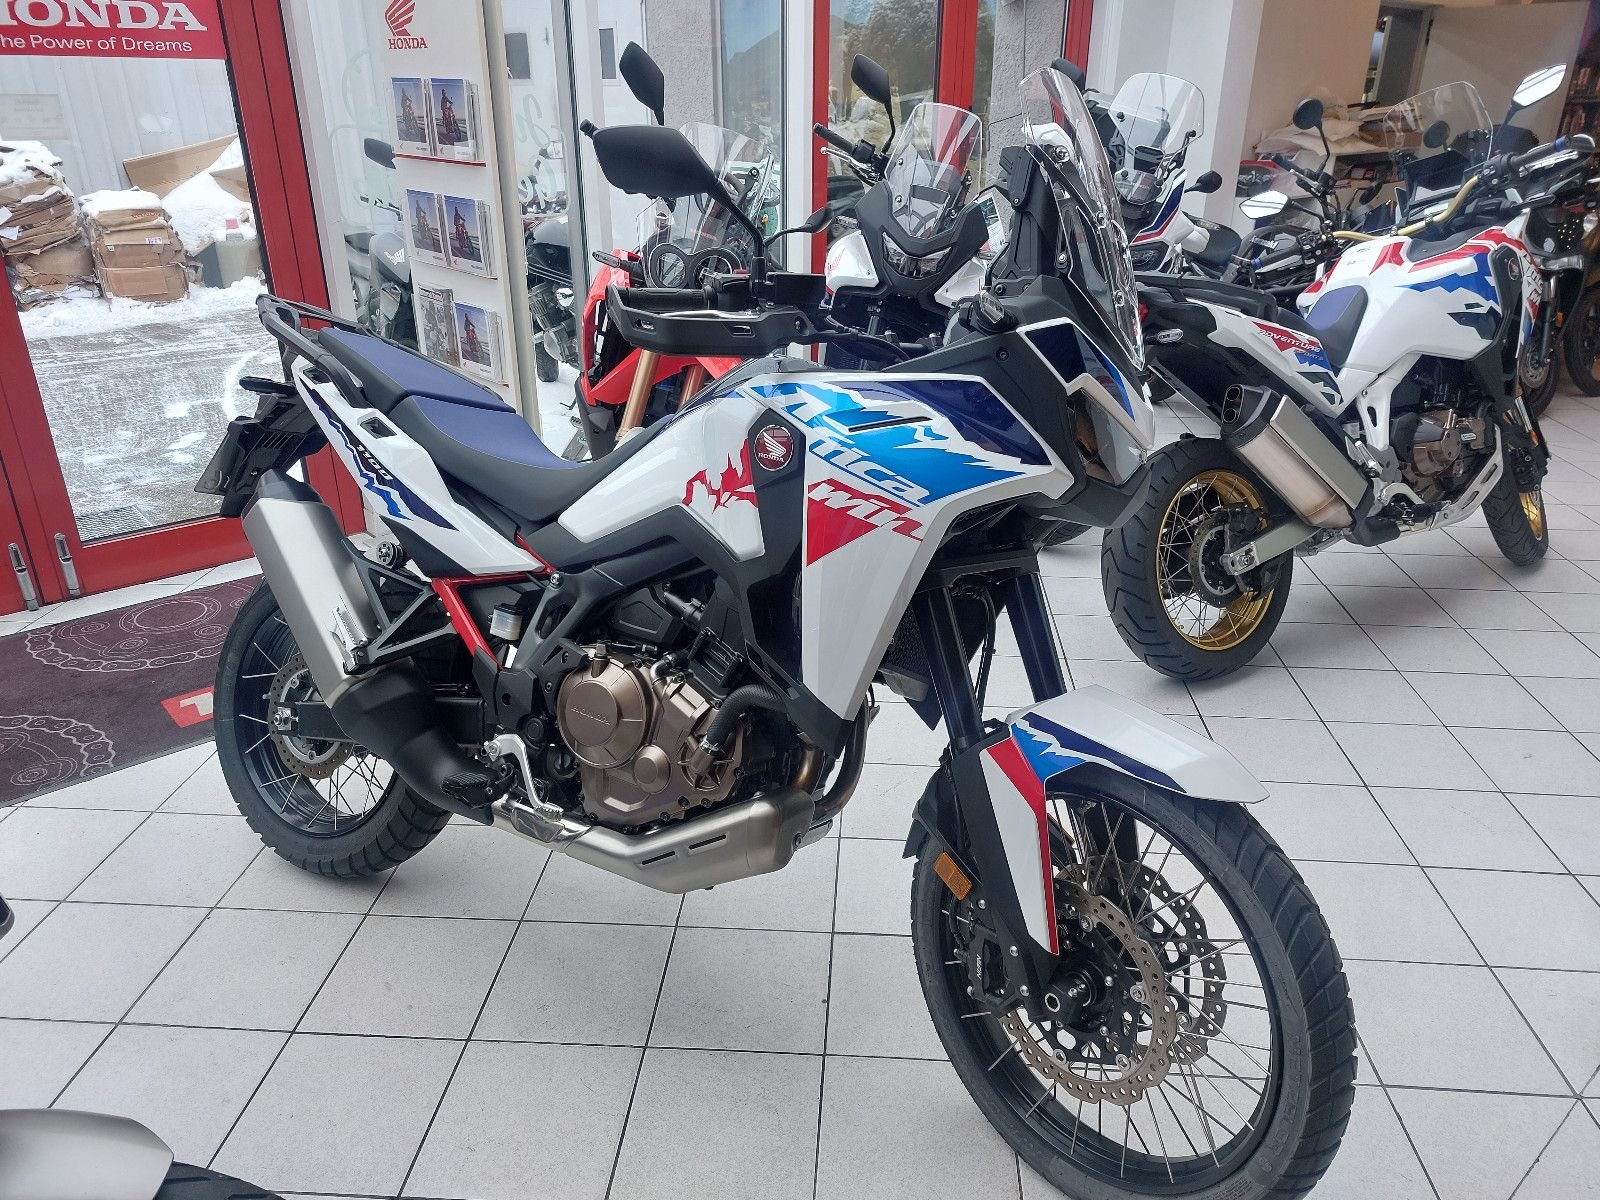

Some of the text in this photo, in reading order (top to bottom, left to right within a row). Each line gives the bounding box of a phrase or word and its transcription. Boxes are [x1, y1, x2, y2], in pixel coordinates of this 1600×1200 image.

[0, 34, 193, 52] he Power of Dreams
[388, 37, 428, 50] HONDA
[356, 444, 394, 481] 1100
[758, 452, 785, 463] HONDA
